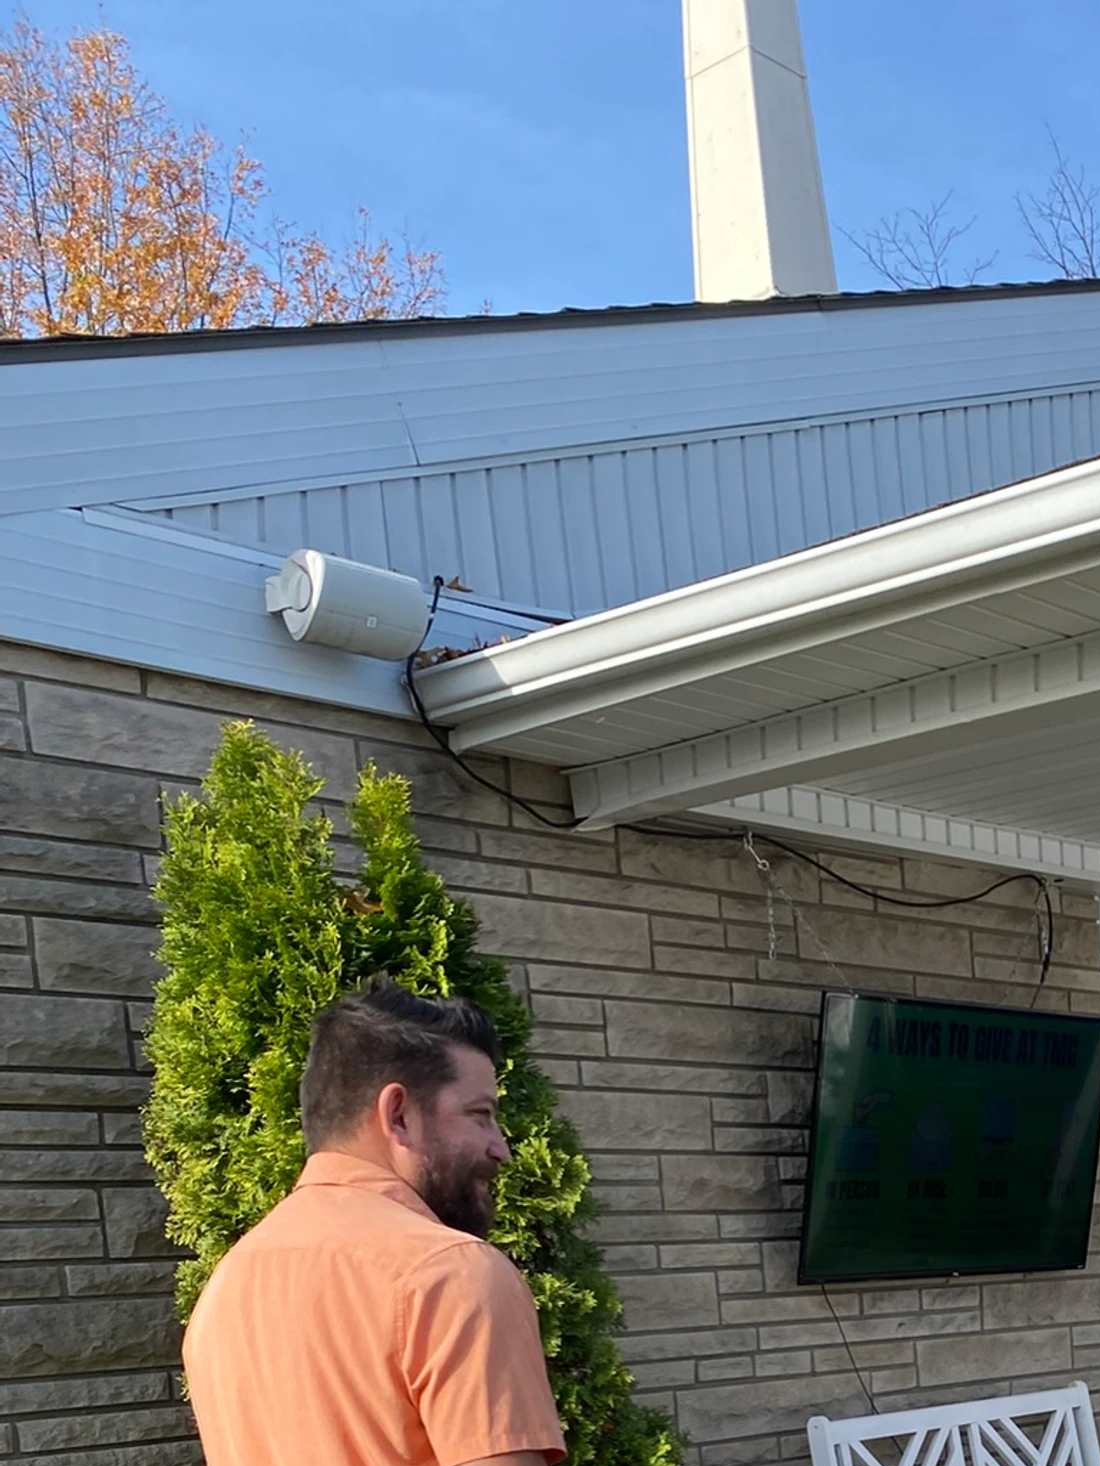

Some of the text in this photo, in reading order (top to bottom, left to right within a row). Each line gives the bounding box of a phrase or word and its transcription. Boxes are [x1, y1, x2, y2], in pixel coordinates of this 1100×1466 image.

[866, 1016, 880, 1054] 4
[888, 1018, 943, 1058] WAYS
[949, 1021, 970, 1061] TO
[975, 1024, 1013, 1065] GIVE
[1016, 1027, 1040, 1065] AT
